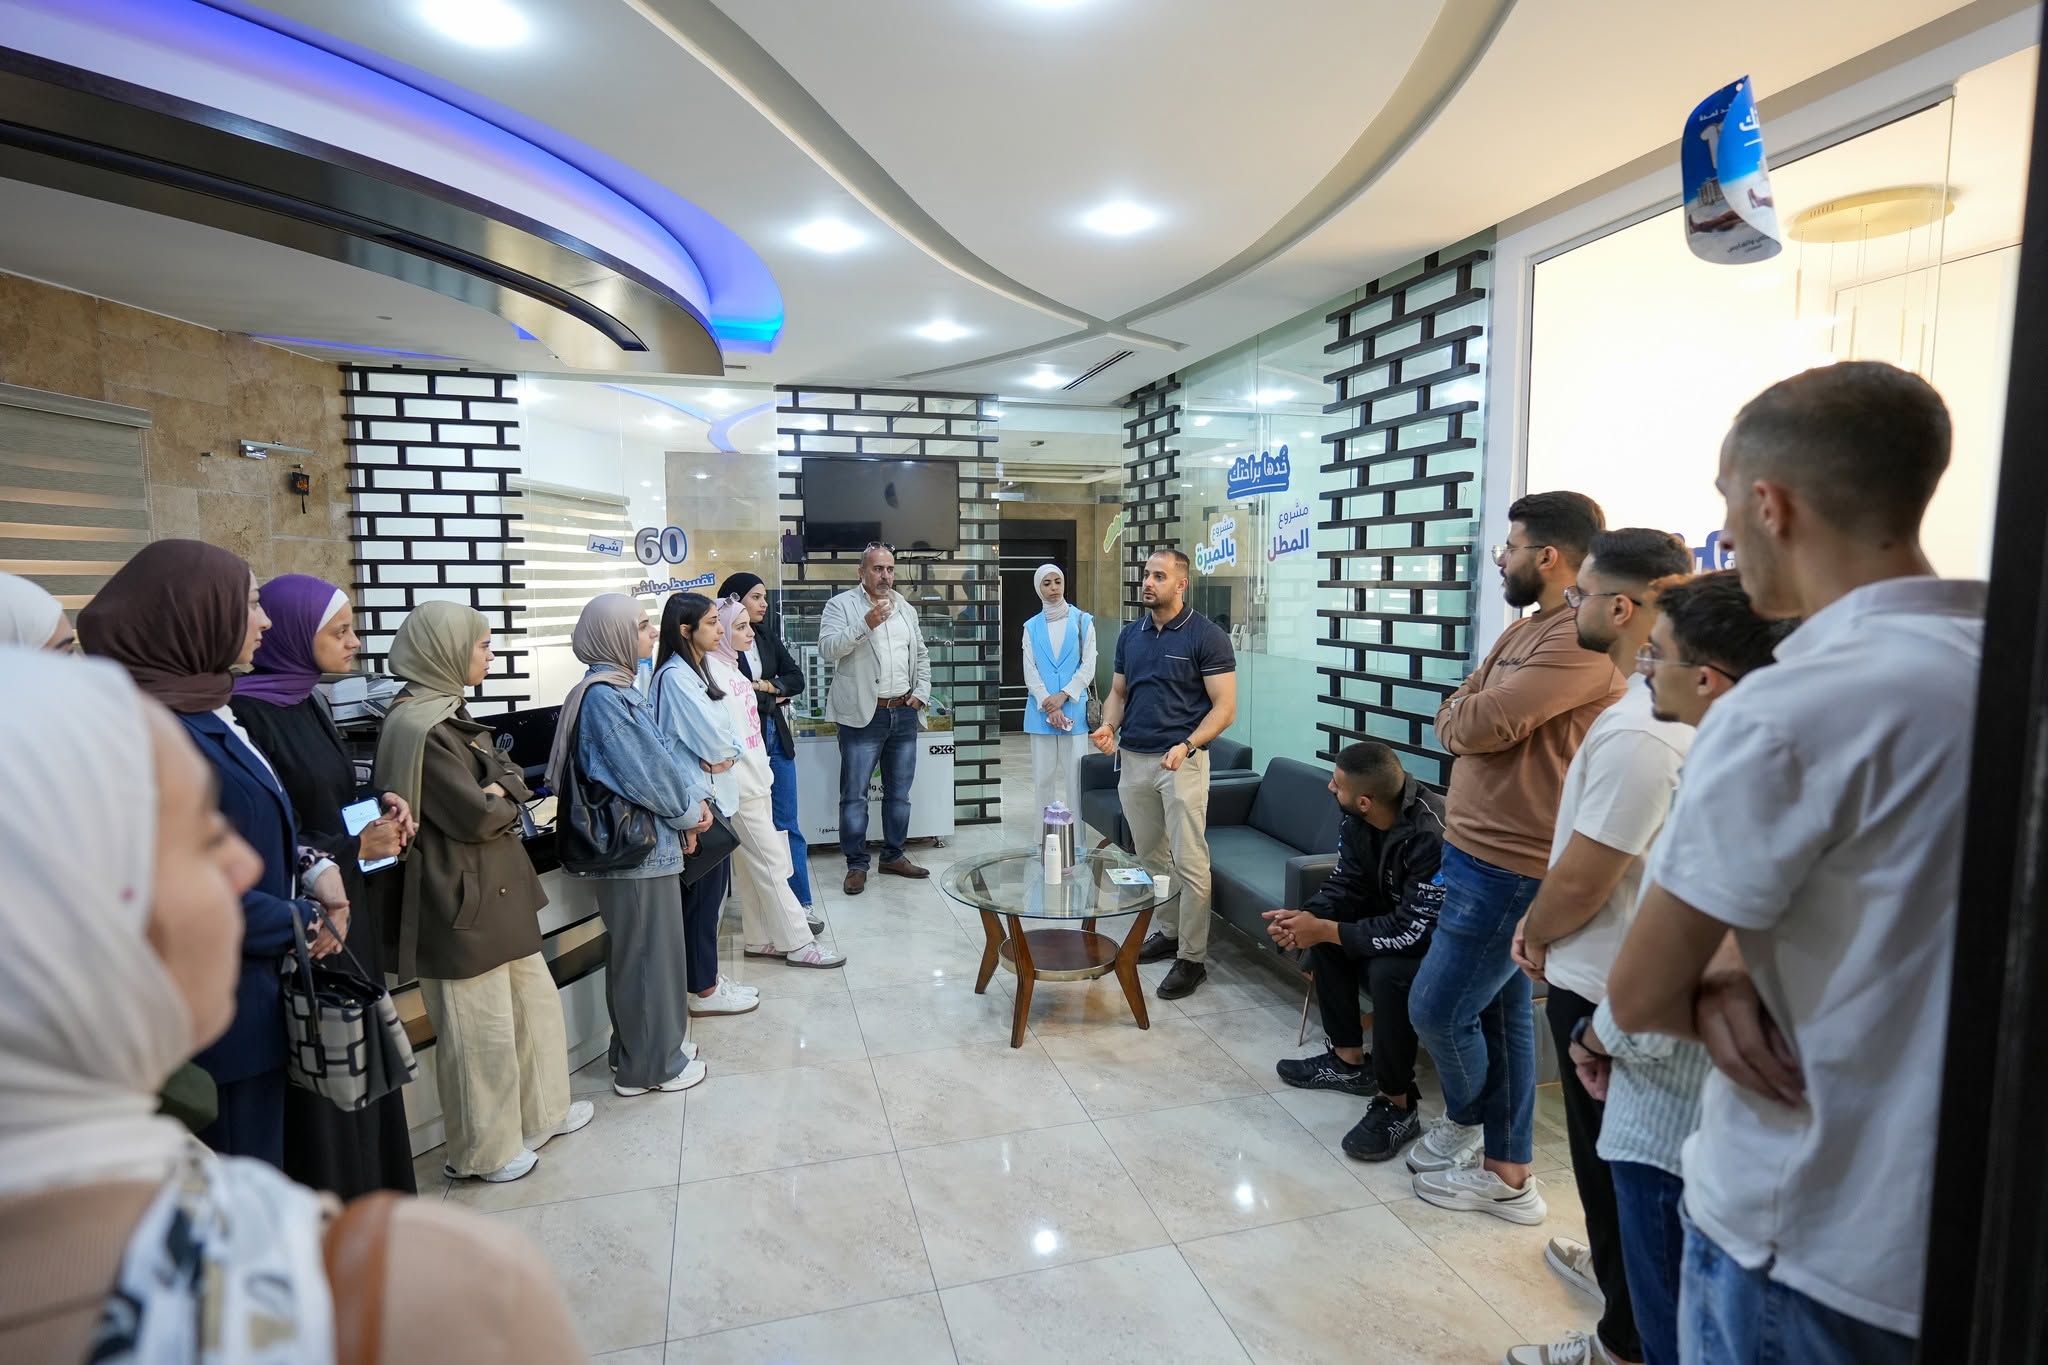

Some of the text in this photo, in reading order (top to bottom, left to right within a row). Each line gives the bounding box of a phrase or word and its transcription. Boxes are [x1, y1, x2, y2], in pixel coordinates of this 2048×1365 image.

[1278, 502, 1309, 529] مشروع
[1212, 518, 1234, 542] مشروع
[591, 541, 619, 552] شهر
[634, 526, 688, 566] 60
[1196, 537, 1235, 570] بالميرة
[1267, 527, 1310, 562] المطل
[632, 574, 715, 596] تقسيط مباشر
